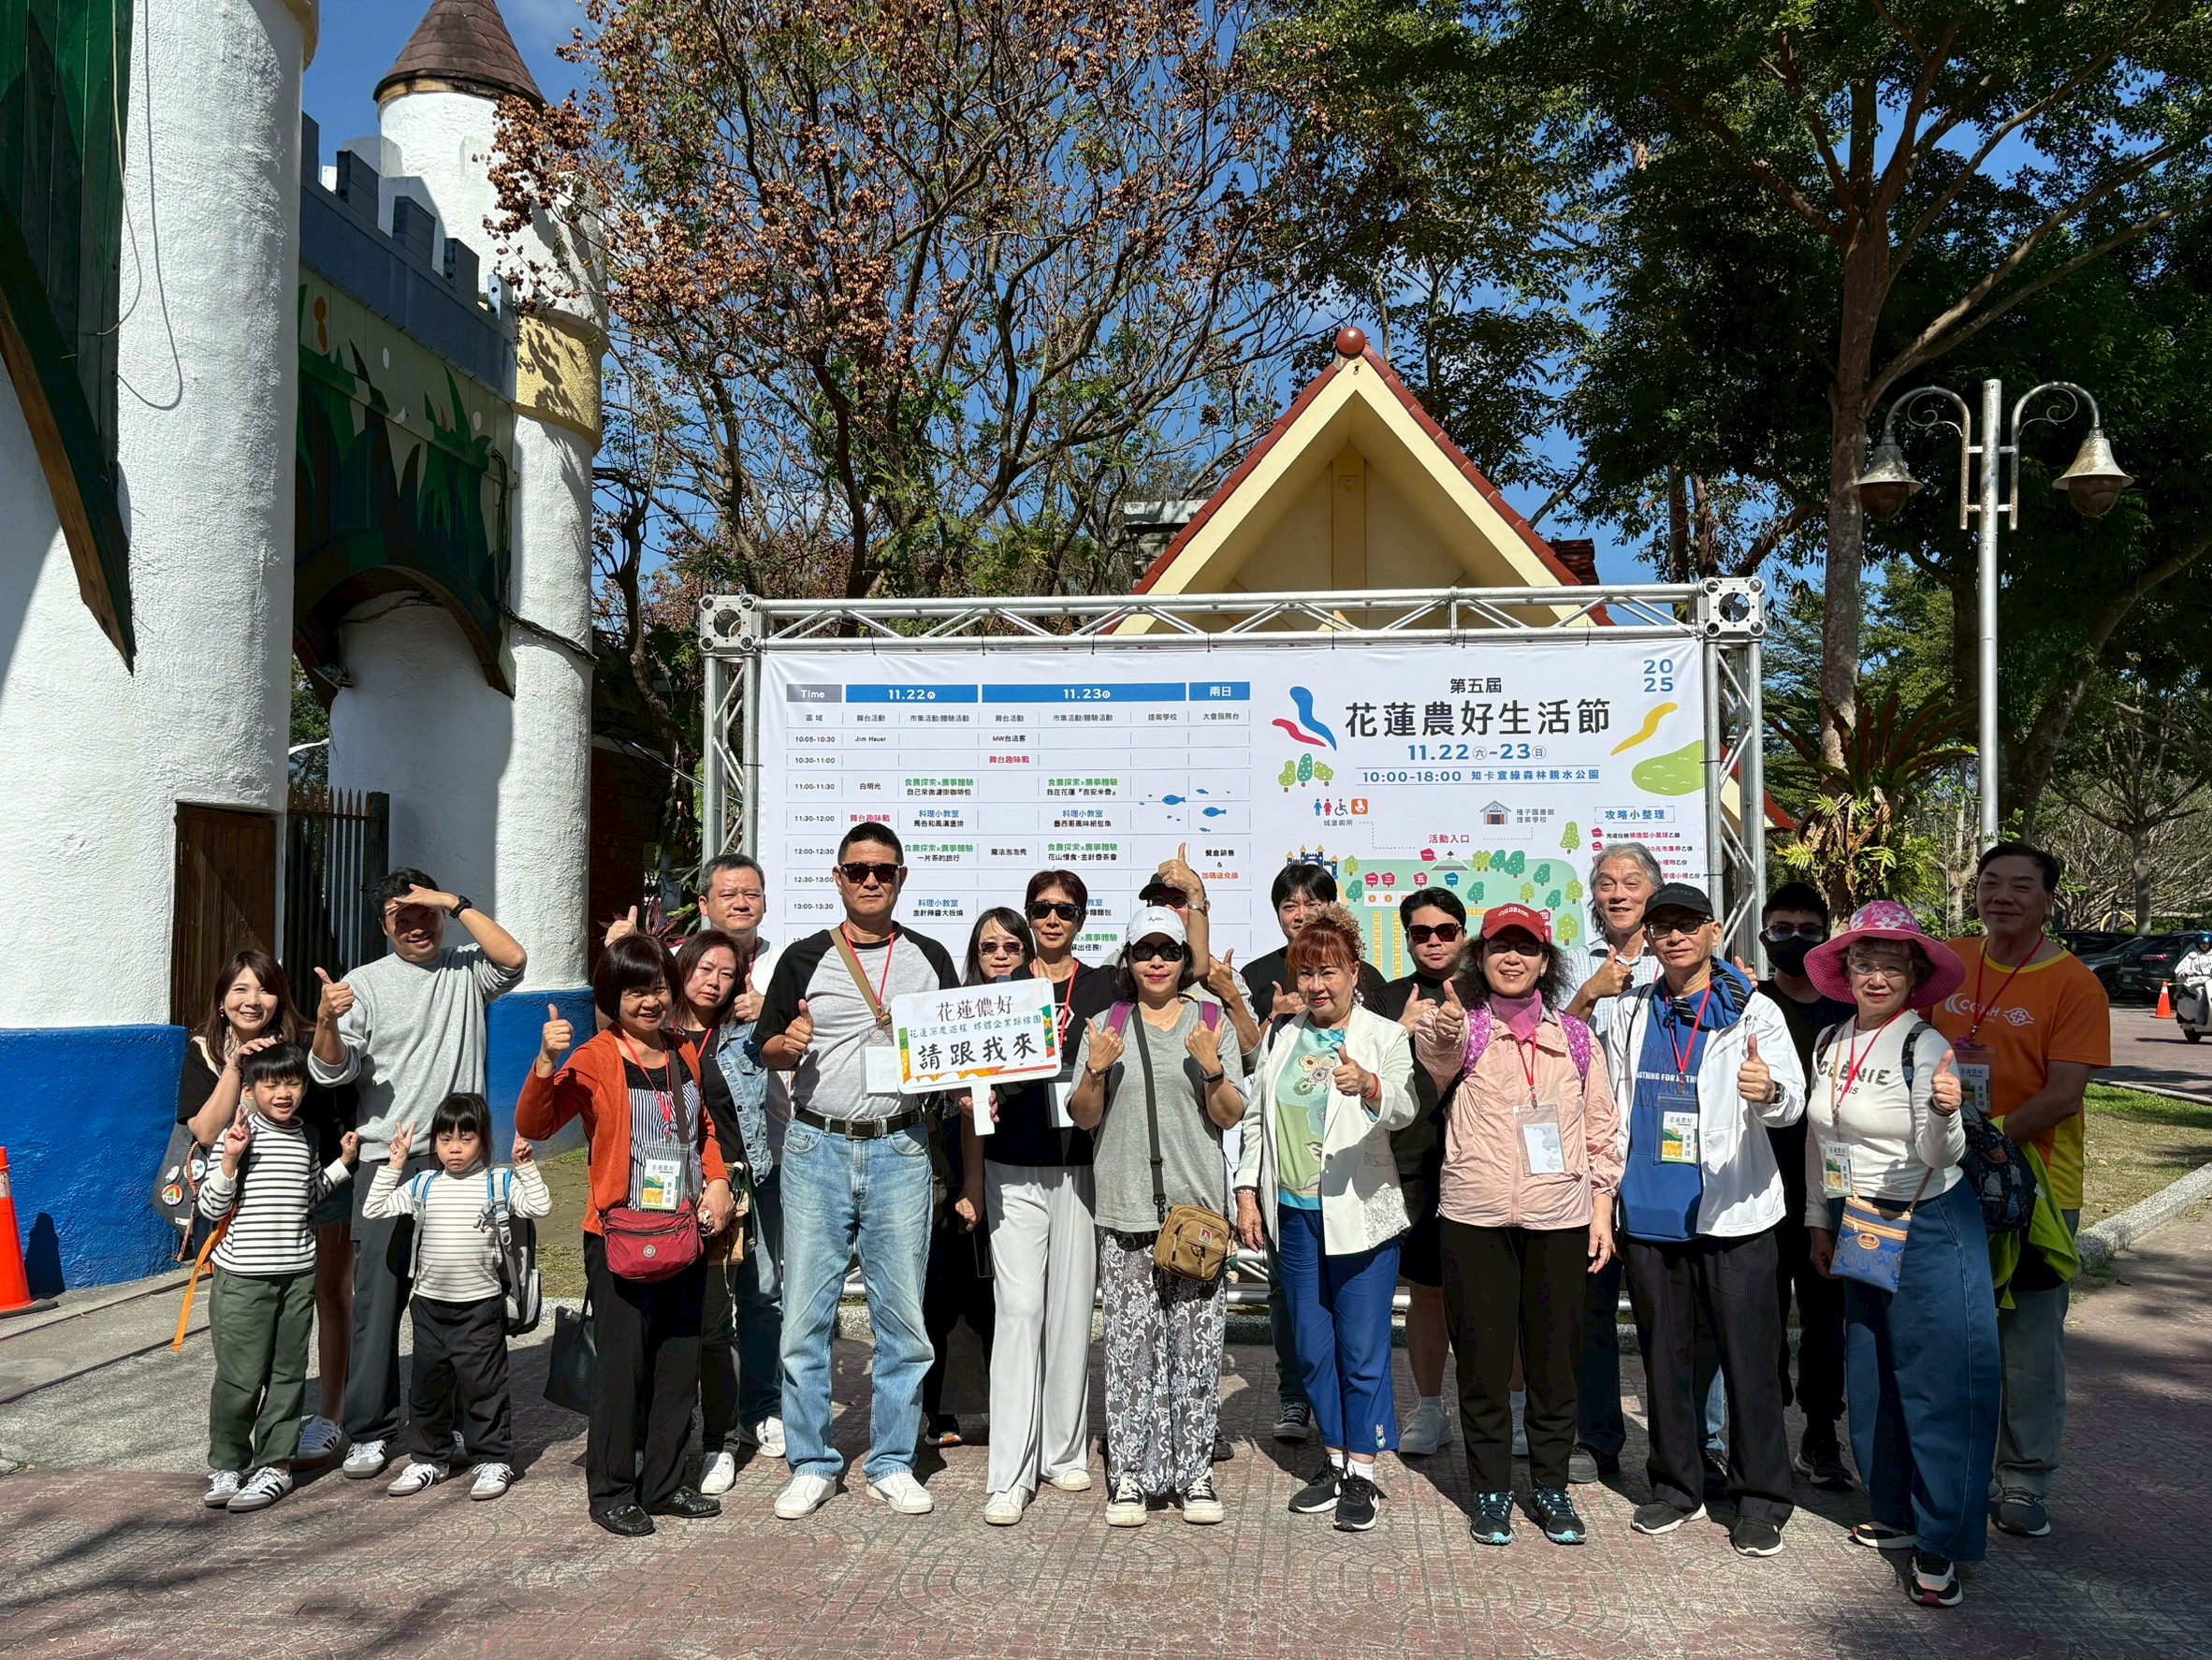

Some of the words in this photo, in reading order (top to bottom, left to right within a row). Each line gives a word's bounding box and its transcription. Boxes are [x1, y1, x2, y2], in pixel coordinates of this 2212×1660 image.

[1643, 659, 1673, 674] 20
[1449, 677, 1503, 694] 第五屆
[1643, 677, 1674, 692] 25
[800, 689, 825, 699] Time
[1209, 686, 1231, 697] 兩日
[1345, 698, 1610, 737] 花蓮農好生活節
[1362, 771, 1462, 783] 10:00-18:00
[1471, 769, 1599, 780] 知卡宣綠森林親水公園
[919, 809, 959, 818] 料理小教室
[1062, 809, 1103, 818] 料理小教室
[1605, 809, 1665, 820] 攻略小整理
[1428, 834, 1470, 844] 活動入口
[918, 899, 959, 908] 料理小教室
[936, 995, 1013, 1023] 花蓮儂好
[918, 1032, 1038, 1070] 請跟我來
